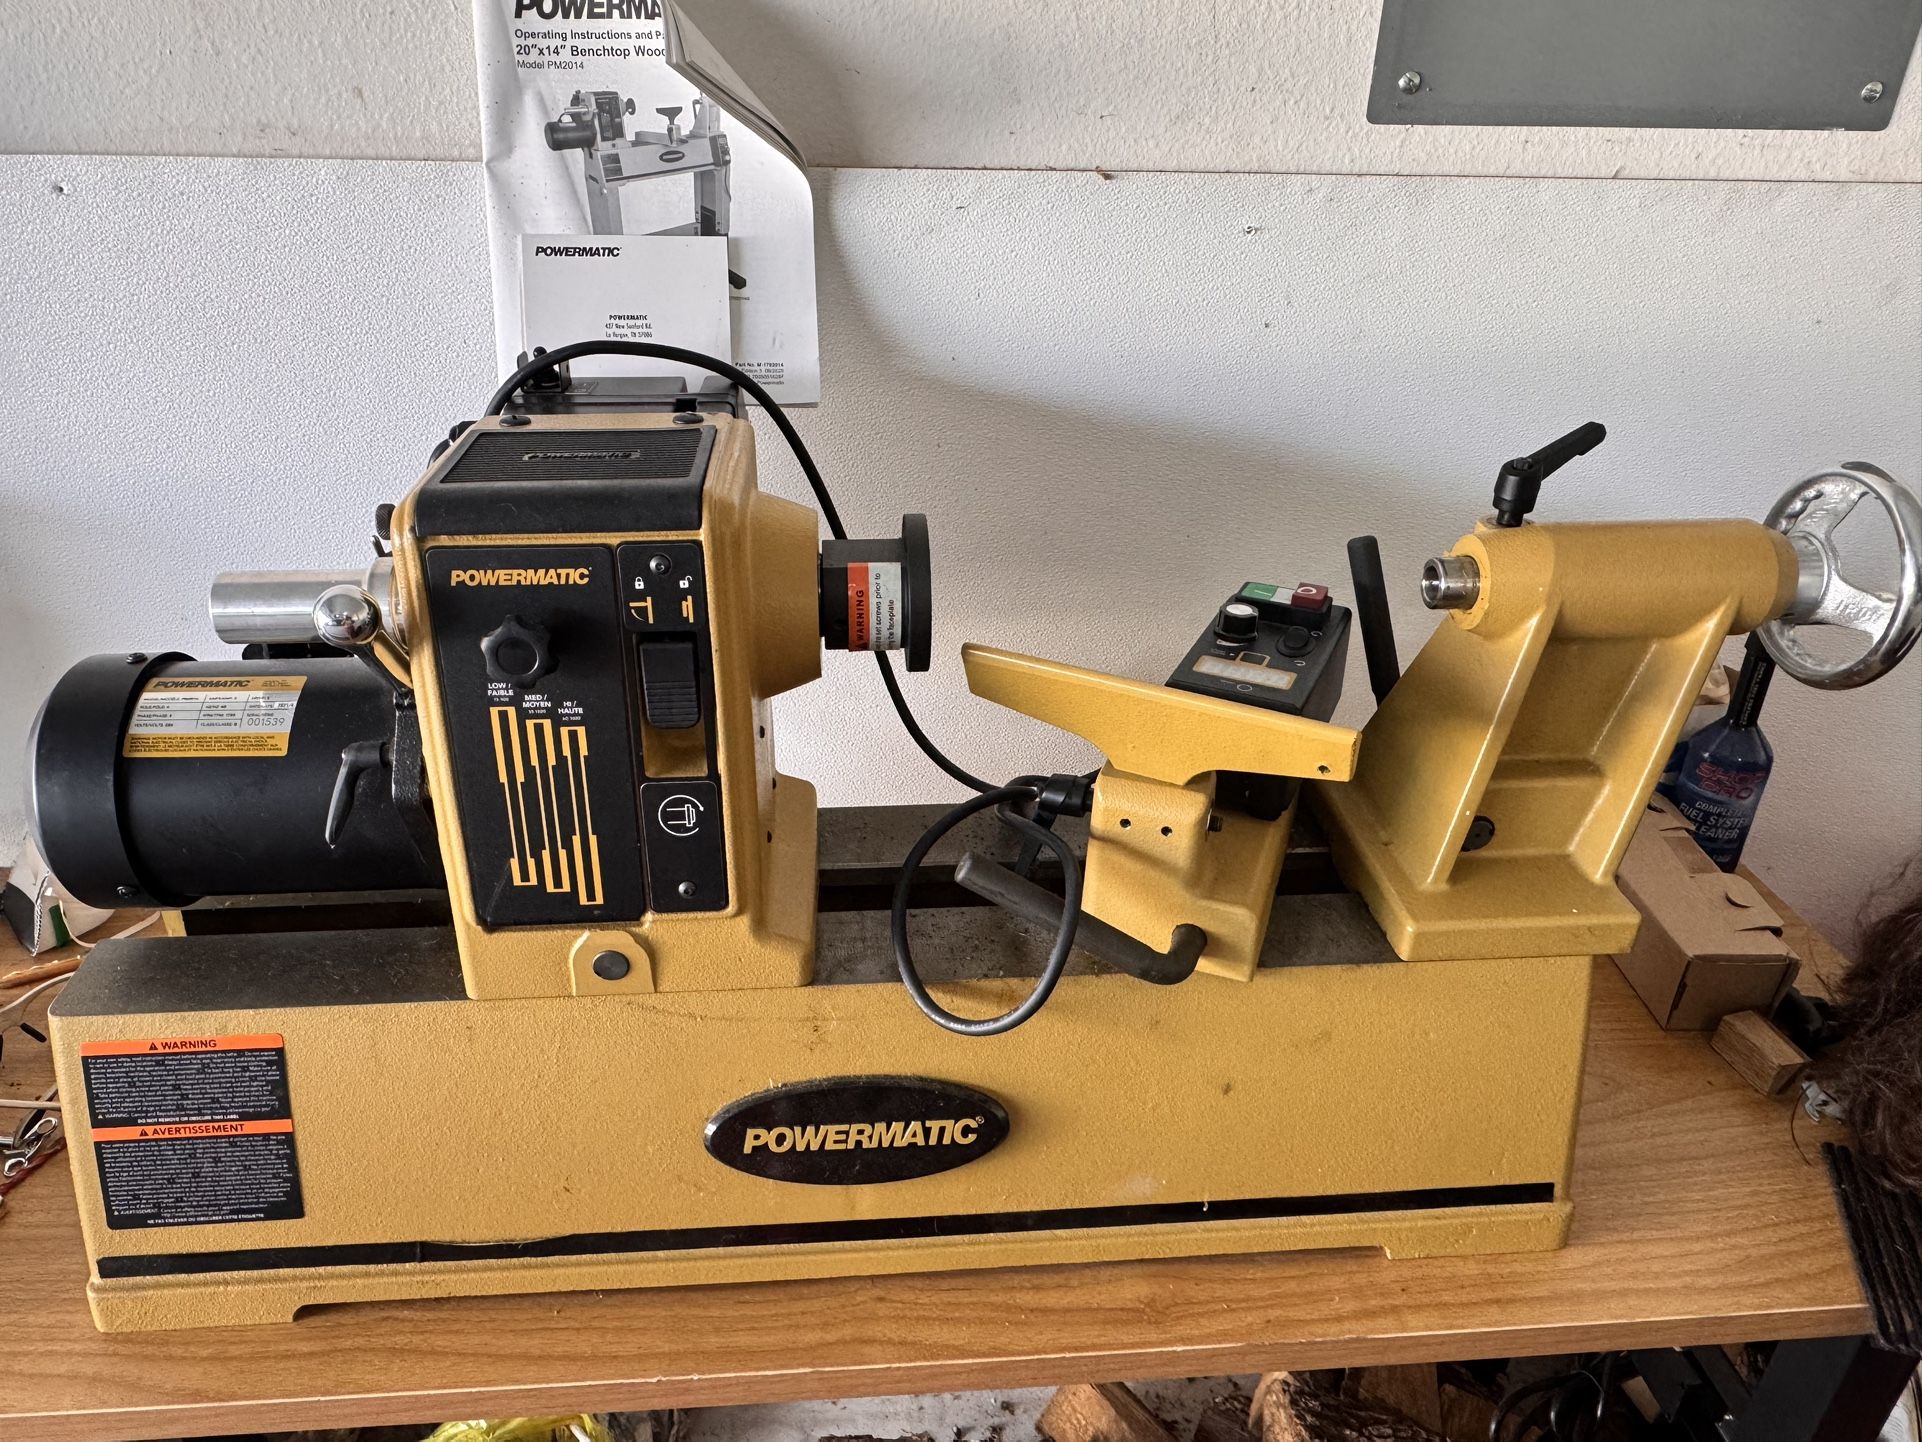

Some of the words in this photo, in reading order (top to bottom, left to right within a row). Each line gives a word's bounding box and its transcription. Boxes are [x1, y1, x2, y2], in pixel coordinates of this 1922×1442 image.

[515, 28, 568, 42] Operating
[570, 28, 632, 40] Instructions
[634, 30, 653, 40] and
[570, 44, 631, 60] Benchtop
[517, 59, 545, 69] Model
[547, 60, 584, 70] PM2014
[535, 246, 620, 258] POWERMATIC
[450, 567, 591, 587] POWERMATIC
[874, 572, 881, 580] to
[875, 582, 883, 599] prior
[855, 589, 865, 642] WARNING
[153, 680, 251, 689] POWERMATIC
[247, 717, 286, 727] 001539
[1678, 802, 1705, 823] FUEL
[160, 1039, 217, 1050] WARNING
[151, 1123, 245, 1136] AVERTISSEMENT
